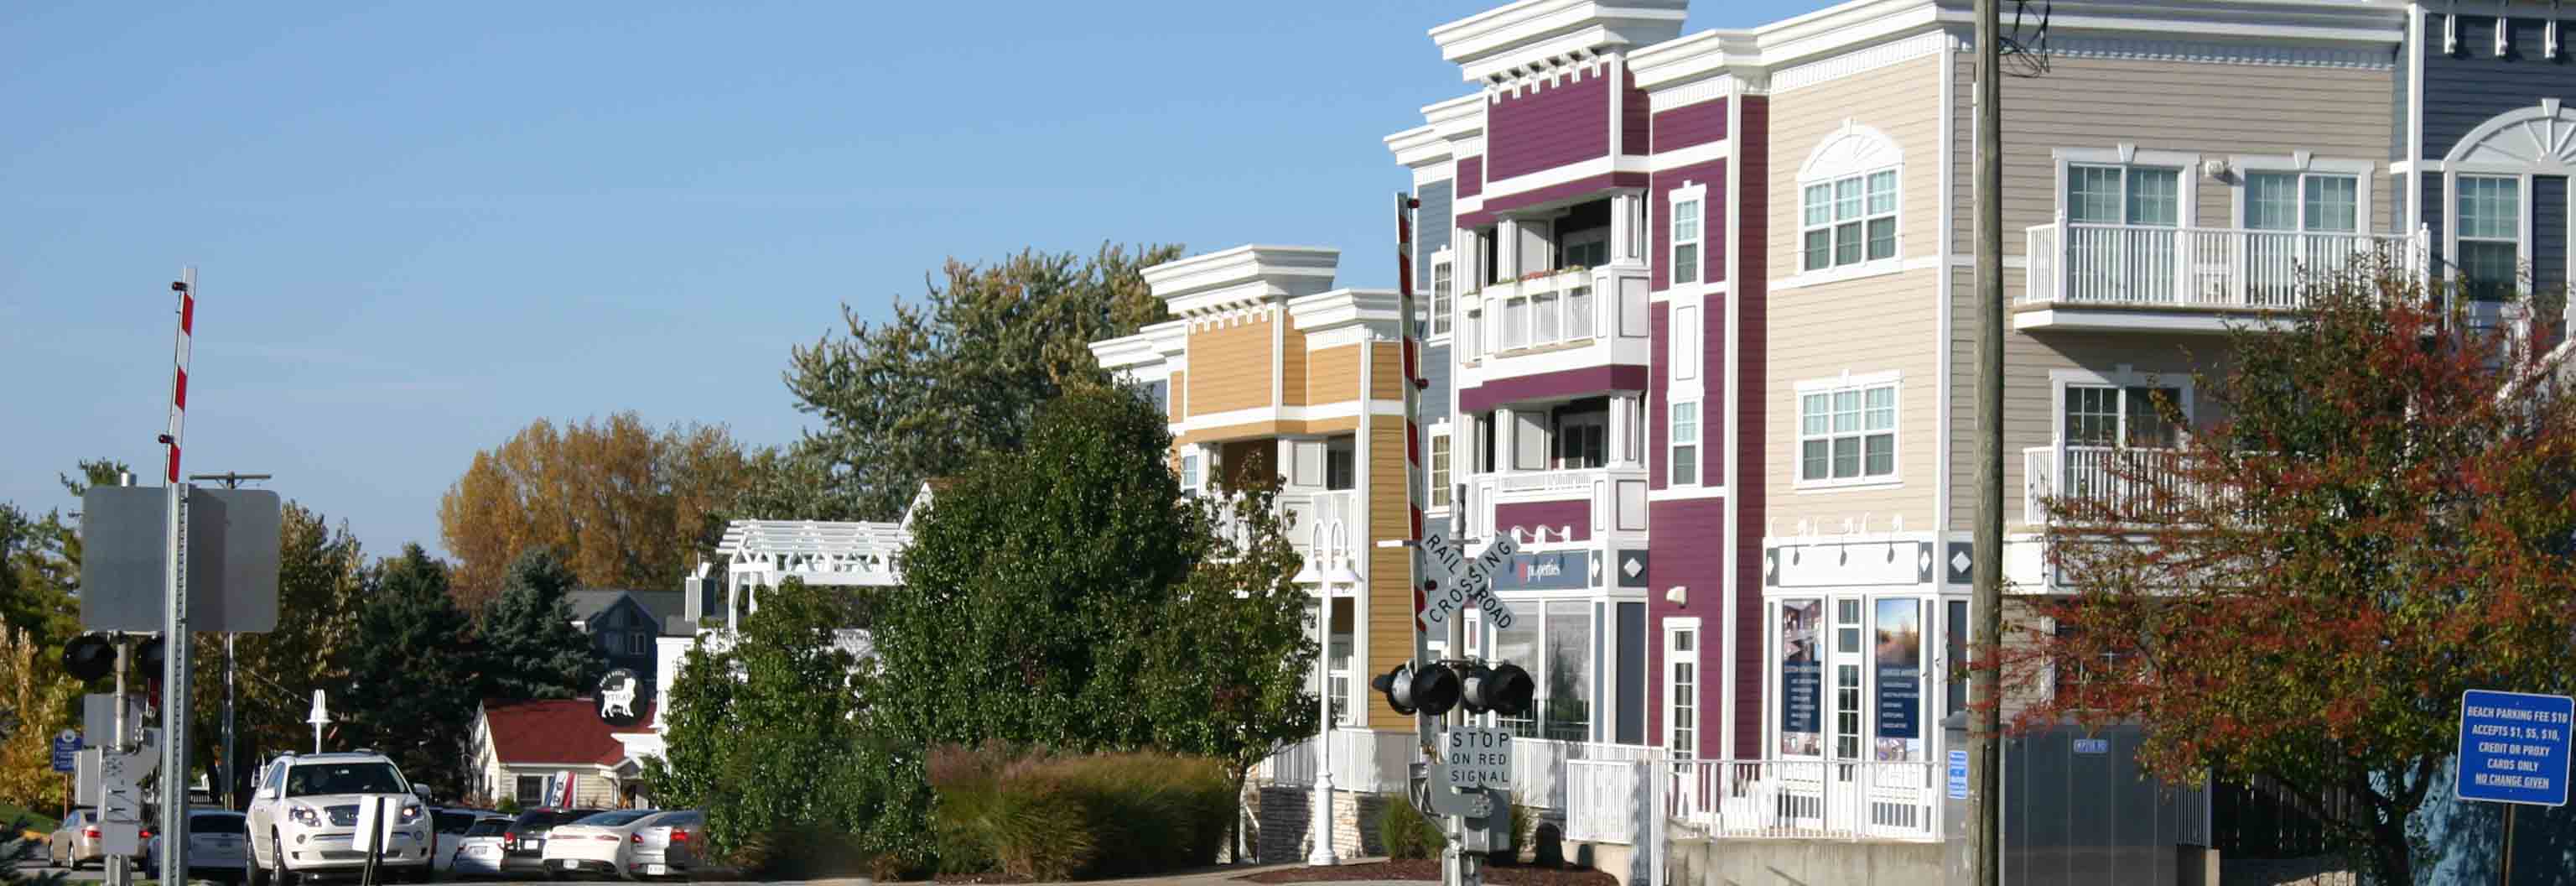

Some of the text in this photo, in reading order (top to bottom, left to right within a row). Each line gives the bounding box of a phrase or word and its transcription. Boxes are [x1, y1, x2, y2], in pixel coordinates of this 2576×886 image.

[1426, 534, 1511, 628] RAIL ROAD
[1429, 541, 1511, 623] CROSSING
[2468, 706, 2568, 723] BEACH PARKING FEE $10
[1452, 732, 1509, 748] STOP
[2472, 724, 2509, 737] ACCEPTS
[2542, 728, 2560, 742] $10,
[2479, 742, 2550, 757] CREDIT OR PROXY
[1452, 753, 1507, 765] ON RED
[2487, 758, 2539, 772] CARDS ONLY
[1452, 770, 1509, 782] SIGNAL
[2475, 772, 2550, 789] NO CHANGE GIVEN
